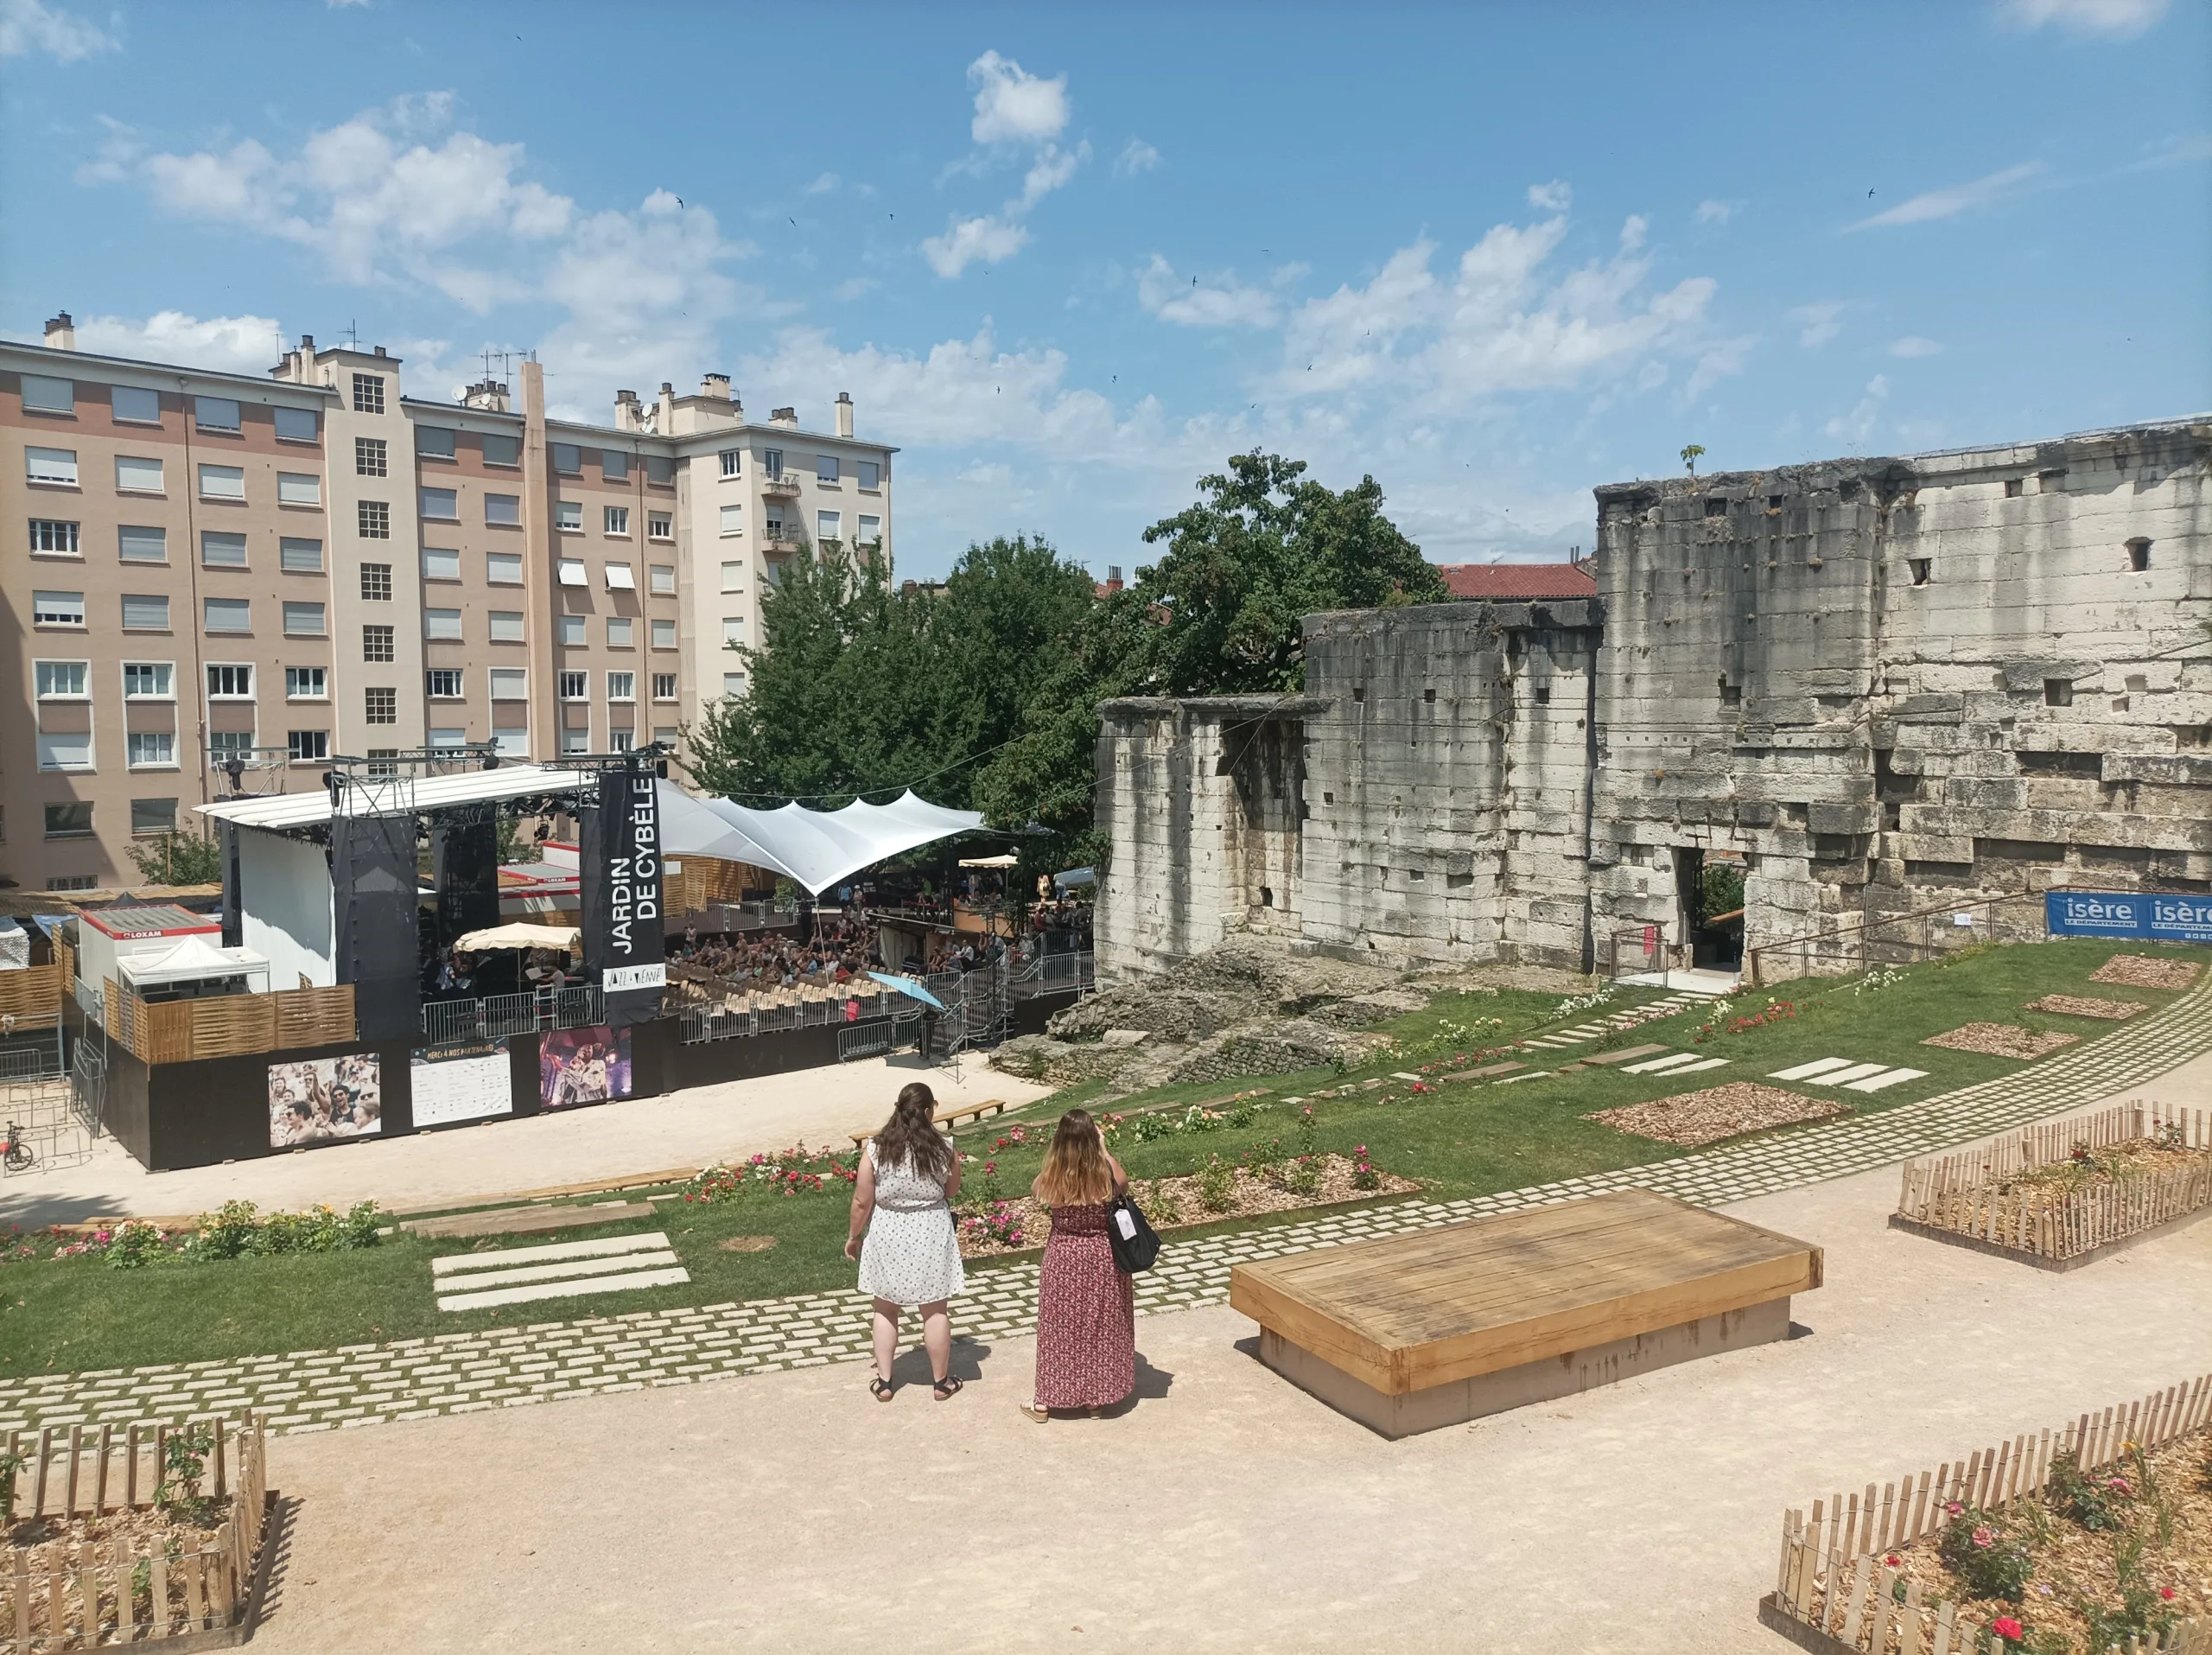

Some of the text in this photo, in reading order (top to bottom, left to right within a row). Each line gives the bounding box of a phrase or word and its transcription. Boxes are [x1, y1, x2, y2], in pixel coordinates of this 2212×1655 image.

[628, 778, 657, 920] DE CYBÈLE
[610, 857, 632, 954] JARDIN
[2067, 898, 2133, 920] isère
